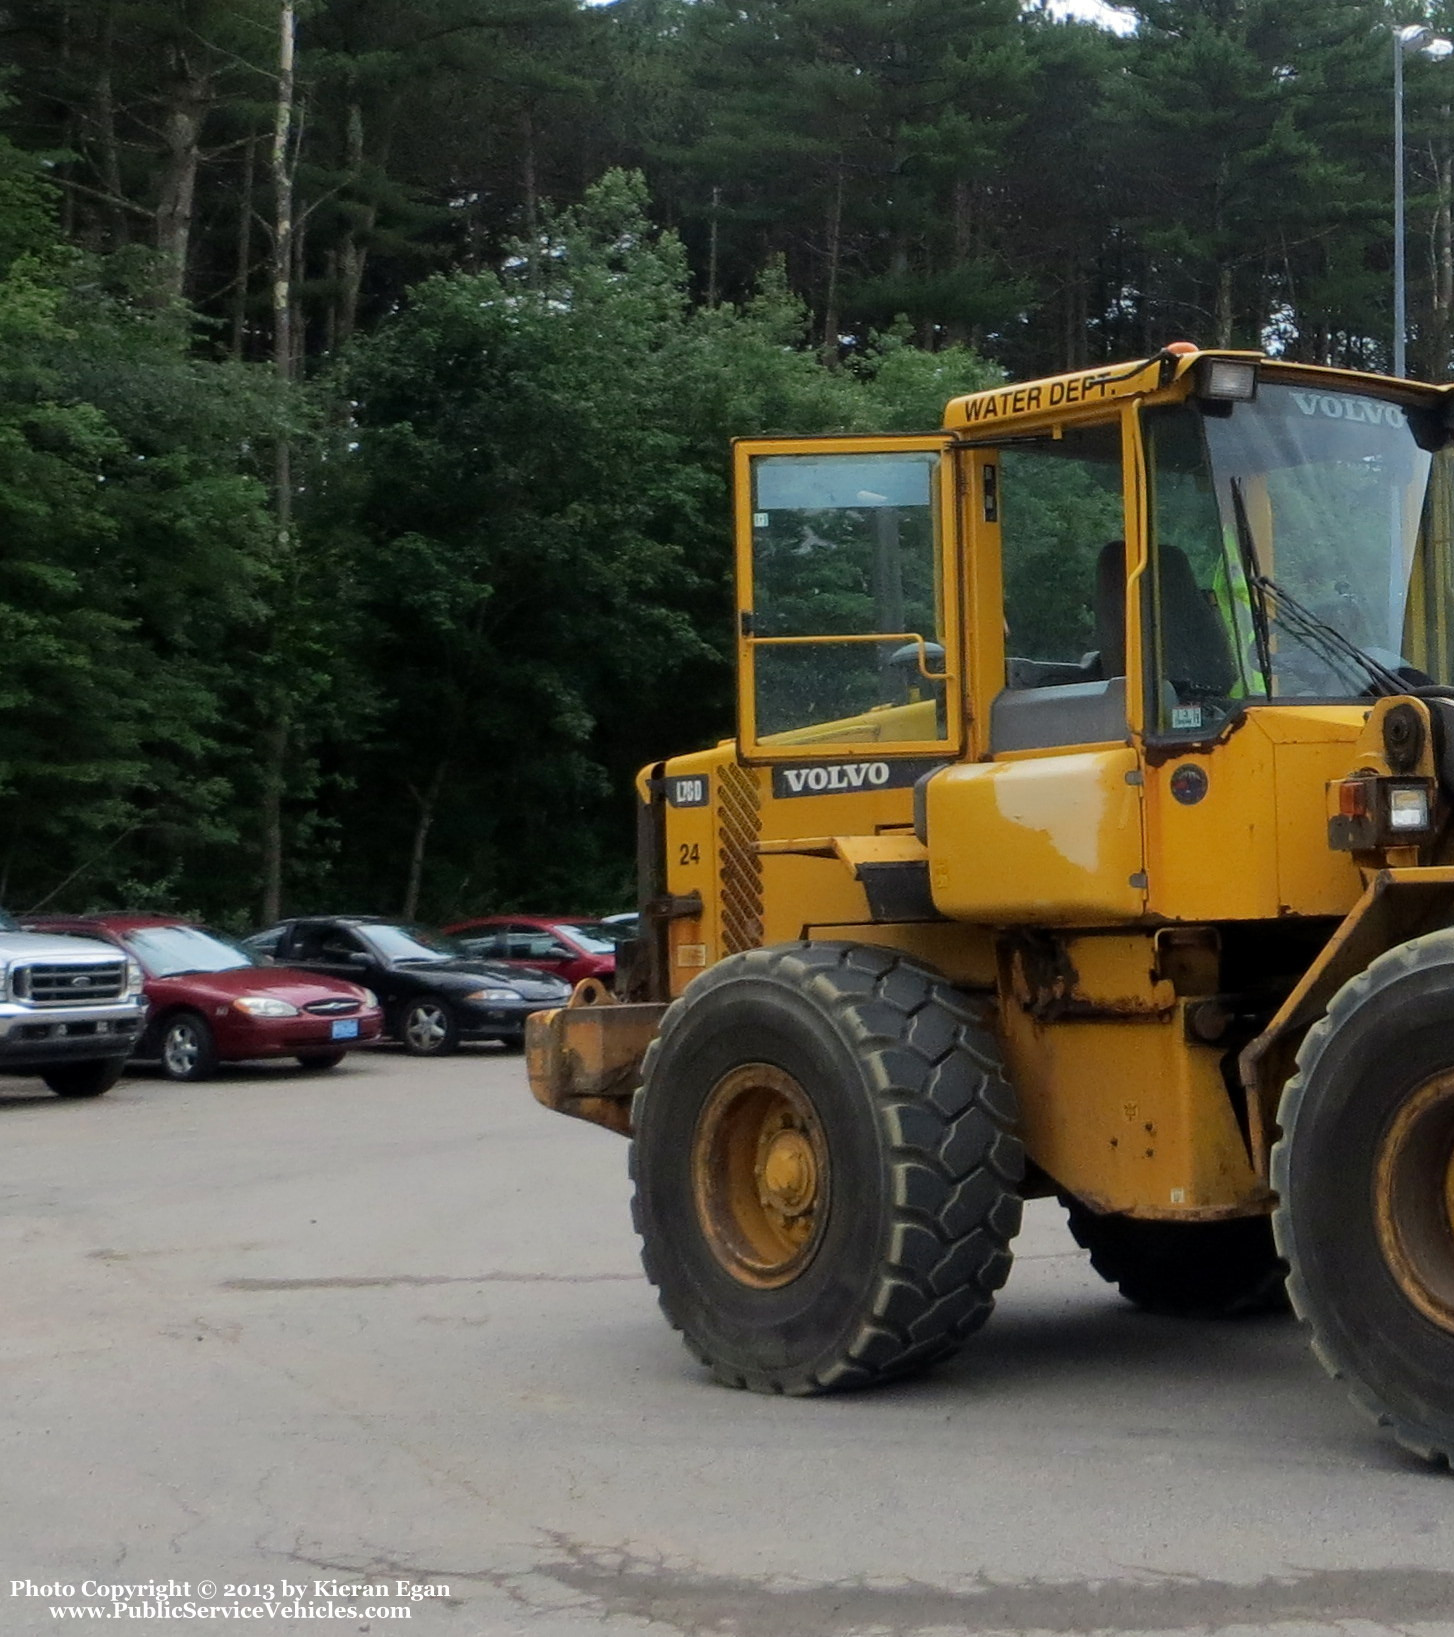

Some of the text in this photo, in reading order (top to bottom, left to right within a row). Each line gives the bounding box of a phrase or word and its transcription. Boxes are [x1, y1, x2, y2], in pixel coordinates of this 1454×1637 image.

[964, 372, 1116, 423] WATER DEPT.
[1287, 391, 1406, 429] VOLVO
[783, 761, 890, 792] VOLVO
[679, 843, 700, 866] 24
